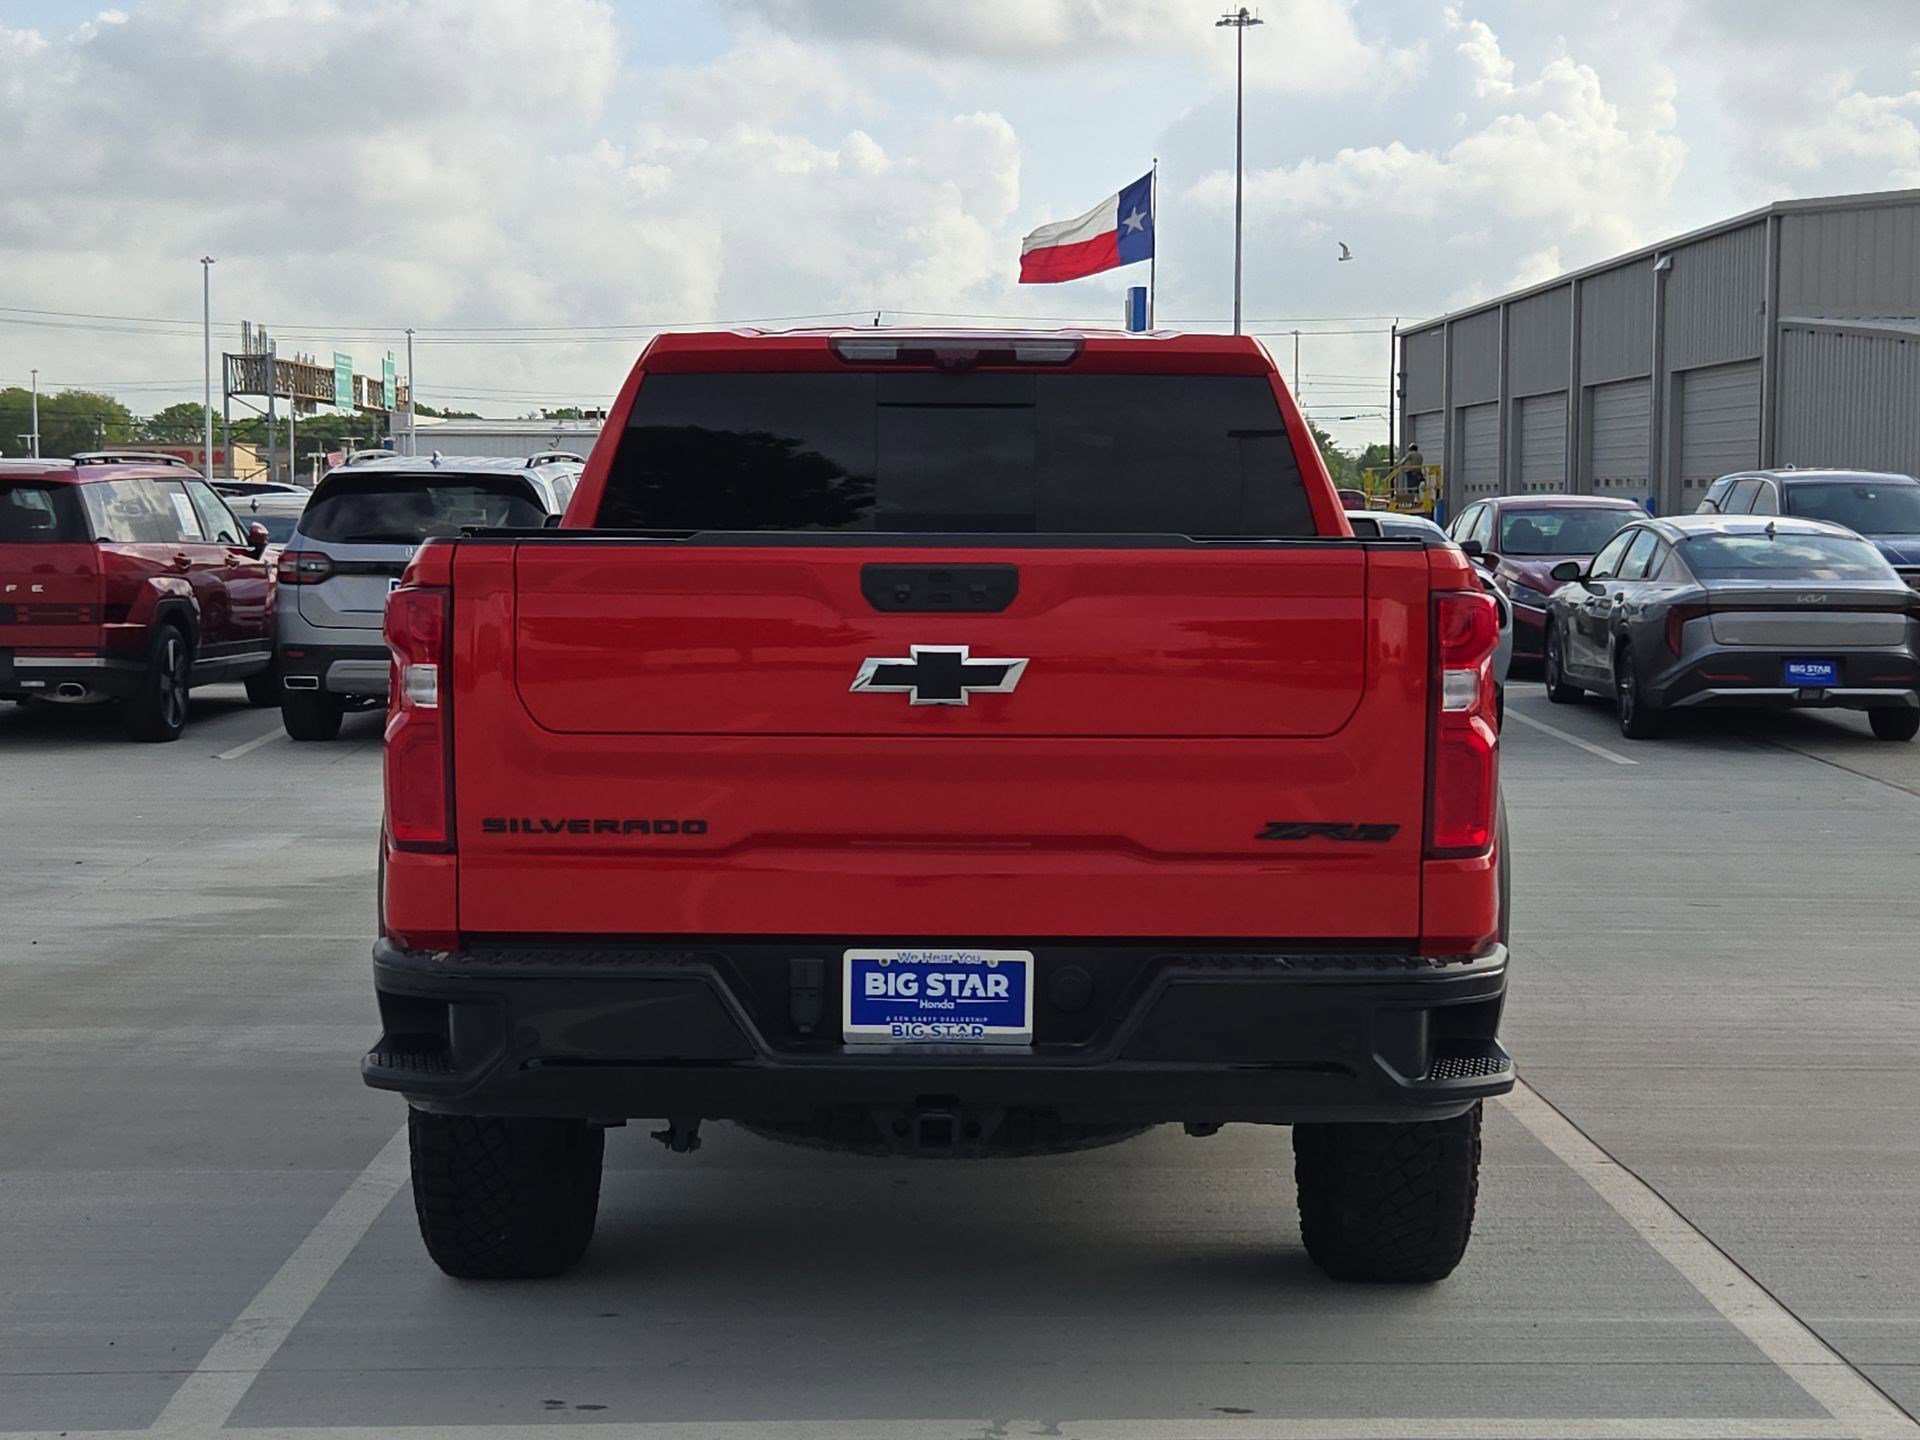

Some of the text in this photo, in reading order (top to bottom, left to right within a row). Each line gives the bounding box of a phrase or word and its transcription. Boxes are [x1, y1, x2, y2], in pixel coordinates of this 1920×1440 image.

[1789, 664, 1832, 674] BIG STAR
[482, 818, 709, 835] SILVERADO
[897, 952, 982, 965] We Hear You
[865, 972, 1009, 998] BIG STAR
[919, 999, 955, 1010] Honda
[891, 1024, 984, 1038] BIG STAR
